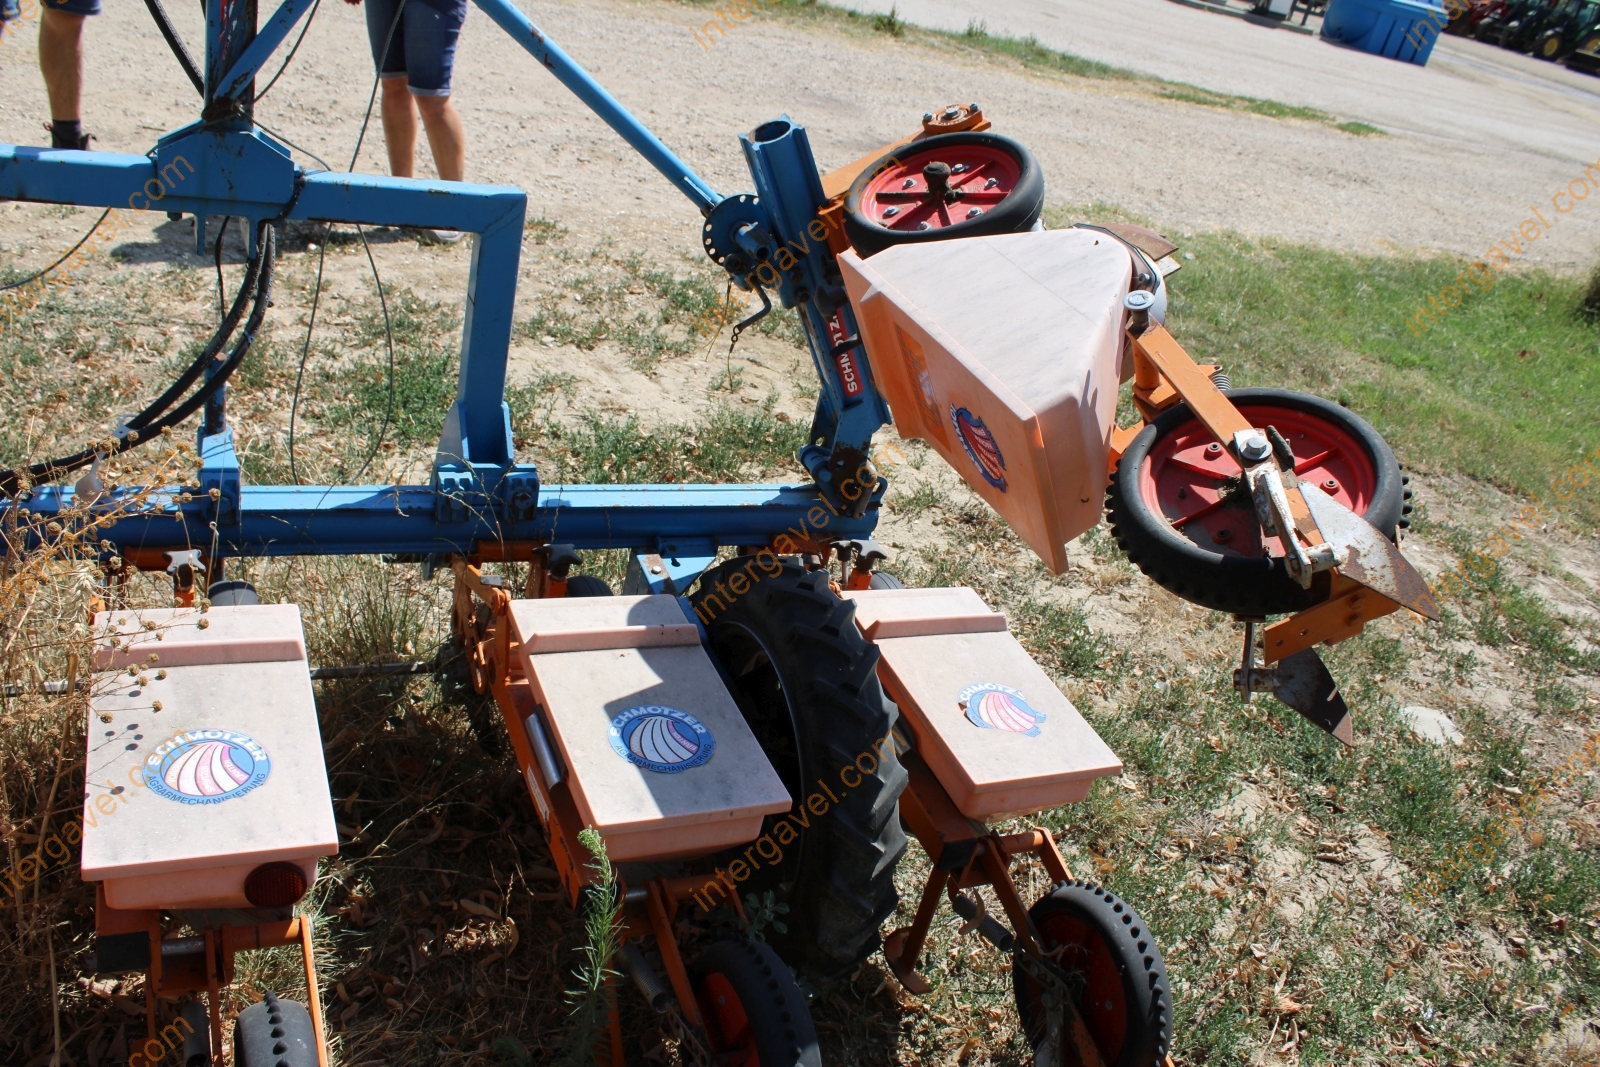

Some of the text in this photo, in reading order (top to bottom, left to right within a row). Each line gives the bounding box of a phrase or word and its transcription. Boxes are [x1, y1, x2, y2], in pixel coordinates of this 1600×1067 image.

[830, 315, 857, 392] SCHMTZ
[610, 706, 706, 737] SCHMOTZER
[147, 730, 268, 766] SCHMOTZER
[615, 743, 712, 772] AGRARMECHANISIERUNG
[147, 773, 266, 806] AGRARMECHANISIERUNG
